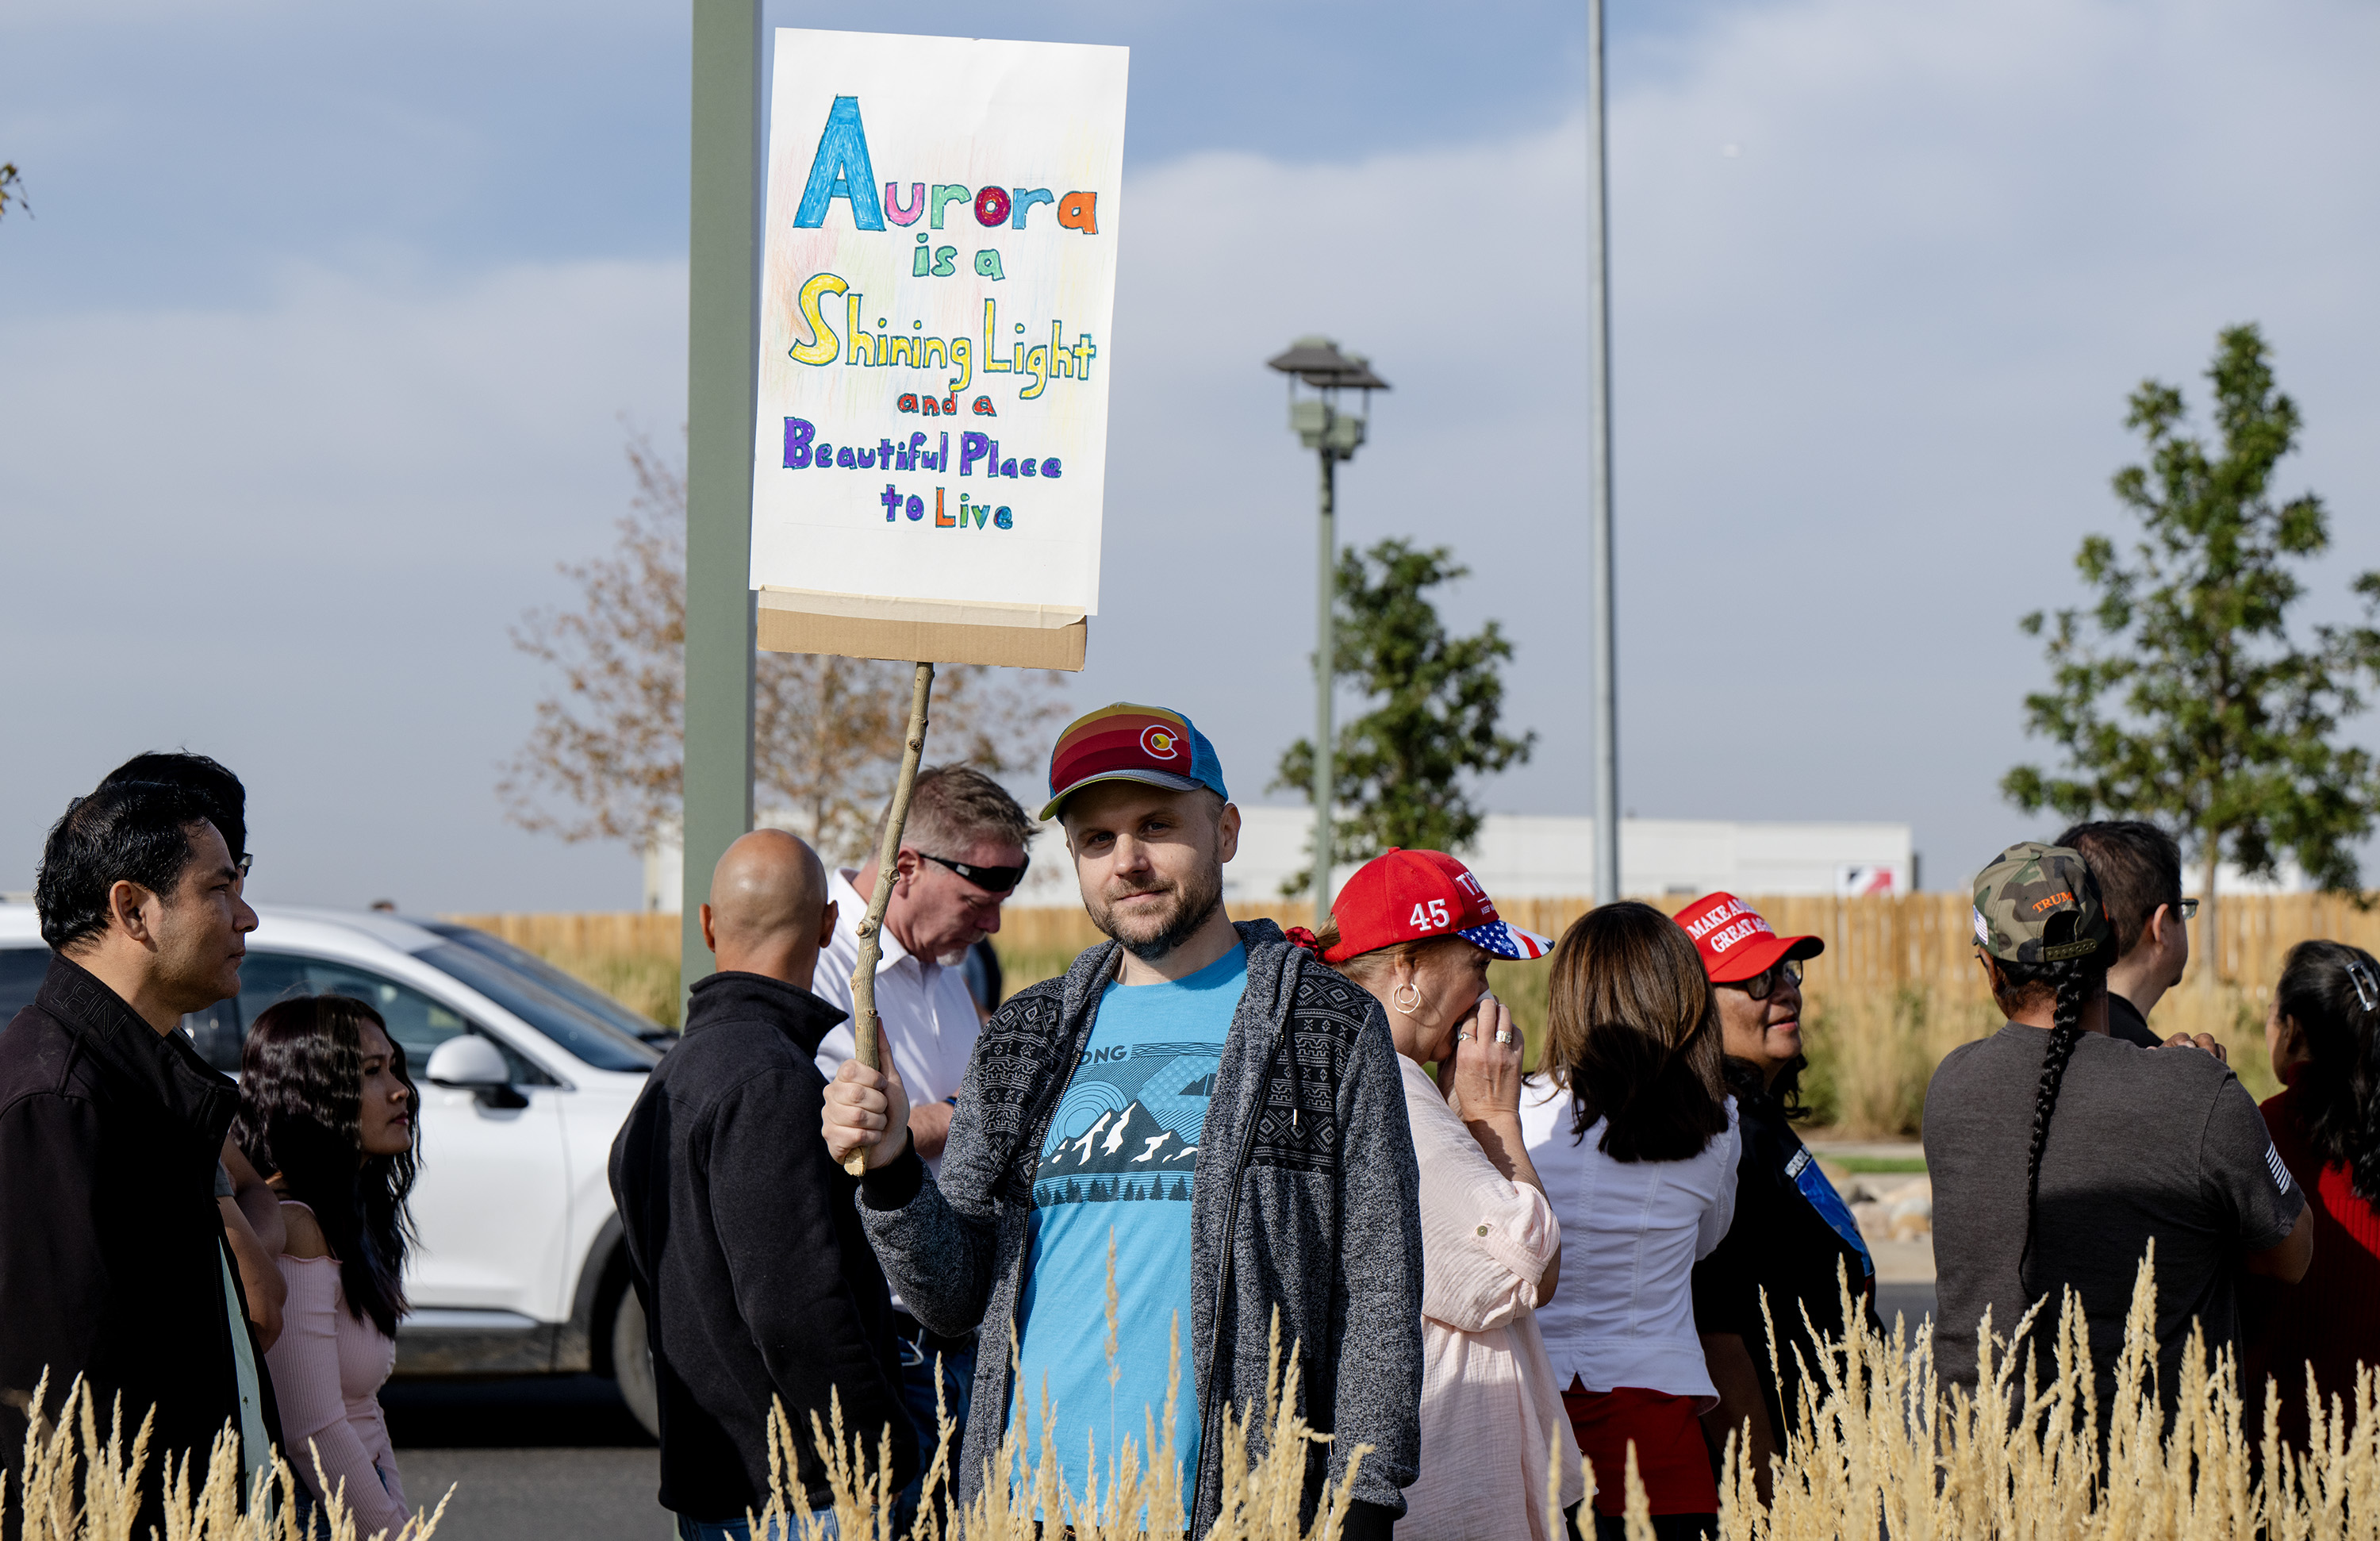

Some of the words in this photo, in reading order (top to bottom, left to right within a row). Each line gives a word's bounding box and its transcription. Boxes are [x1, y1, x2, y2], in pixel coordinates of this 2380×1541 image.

[793, 94, 1099, 235] Aurora
[912, 232, 958, 277] is
[975, 248, 1006, 281] a
[789, 272, 973, 393] Shining
[983, 298, 1096, 400] Light
[897, 391, 958, 417] and
[972, 395, 997, 417] a
[782, 417, 949, 473] Beautiful
[960, 431, 1062, 478] Place
[881, 484, 924, 522] to
[935, 486, 1013, 530] Live
[1410, 898, 1450, 932] 45
[1686, 904, 1732, 940] MAKE
[2032, 890, 2075, 913] TRUM
[1710, 918, 1756, 953] GREAT
